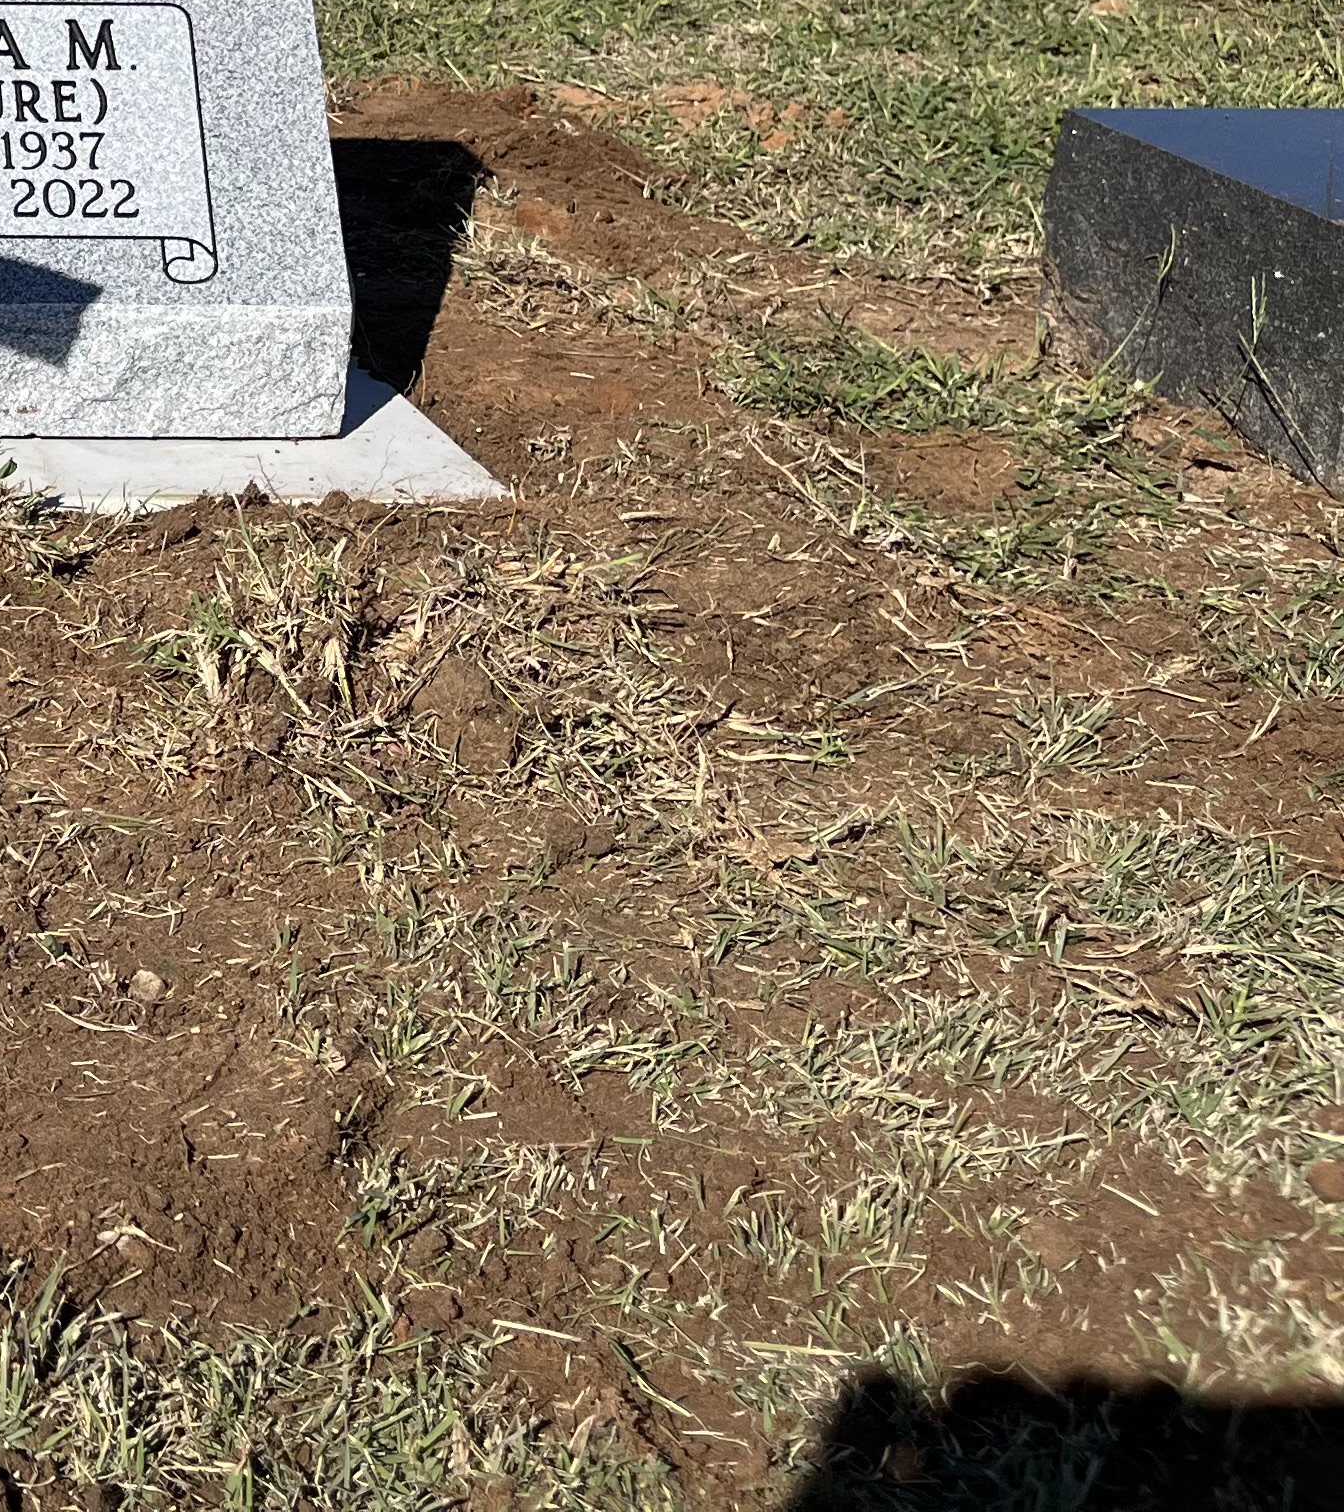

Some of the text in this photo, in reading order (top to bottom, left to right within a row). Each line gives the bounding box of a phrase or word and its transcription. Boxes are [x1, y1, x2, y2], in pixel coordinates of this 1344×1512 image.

[65, 19, 136, 70] M.
[1, 132, 105, 170] 1937
[11, 179, 139, 218] 2022
